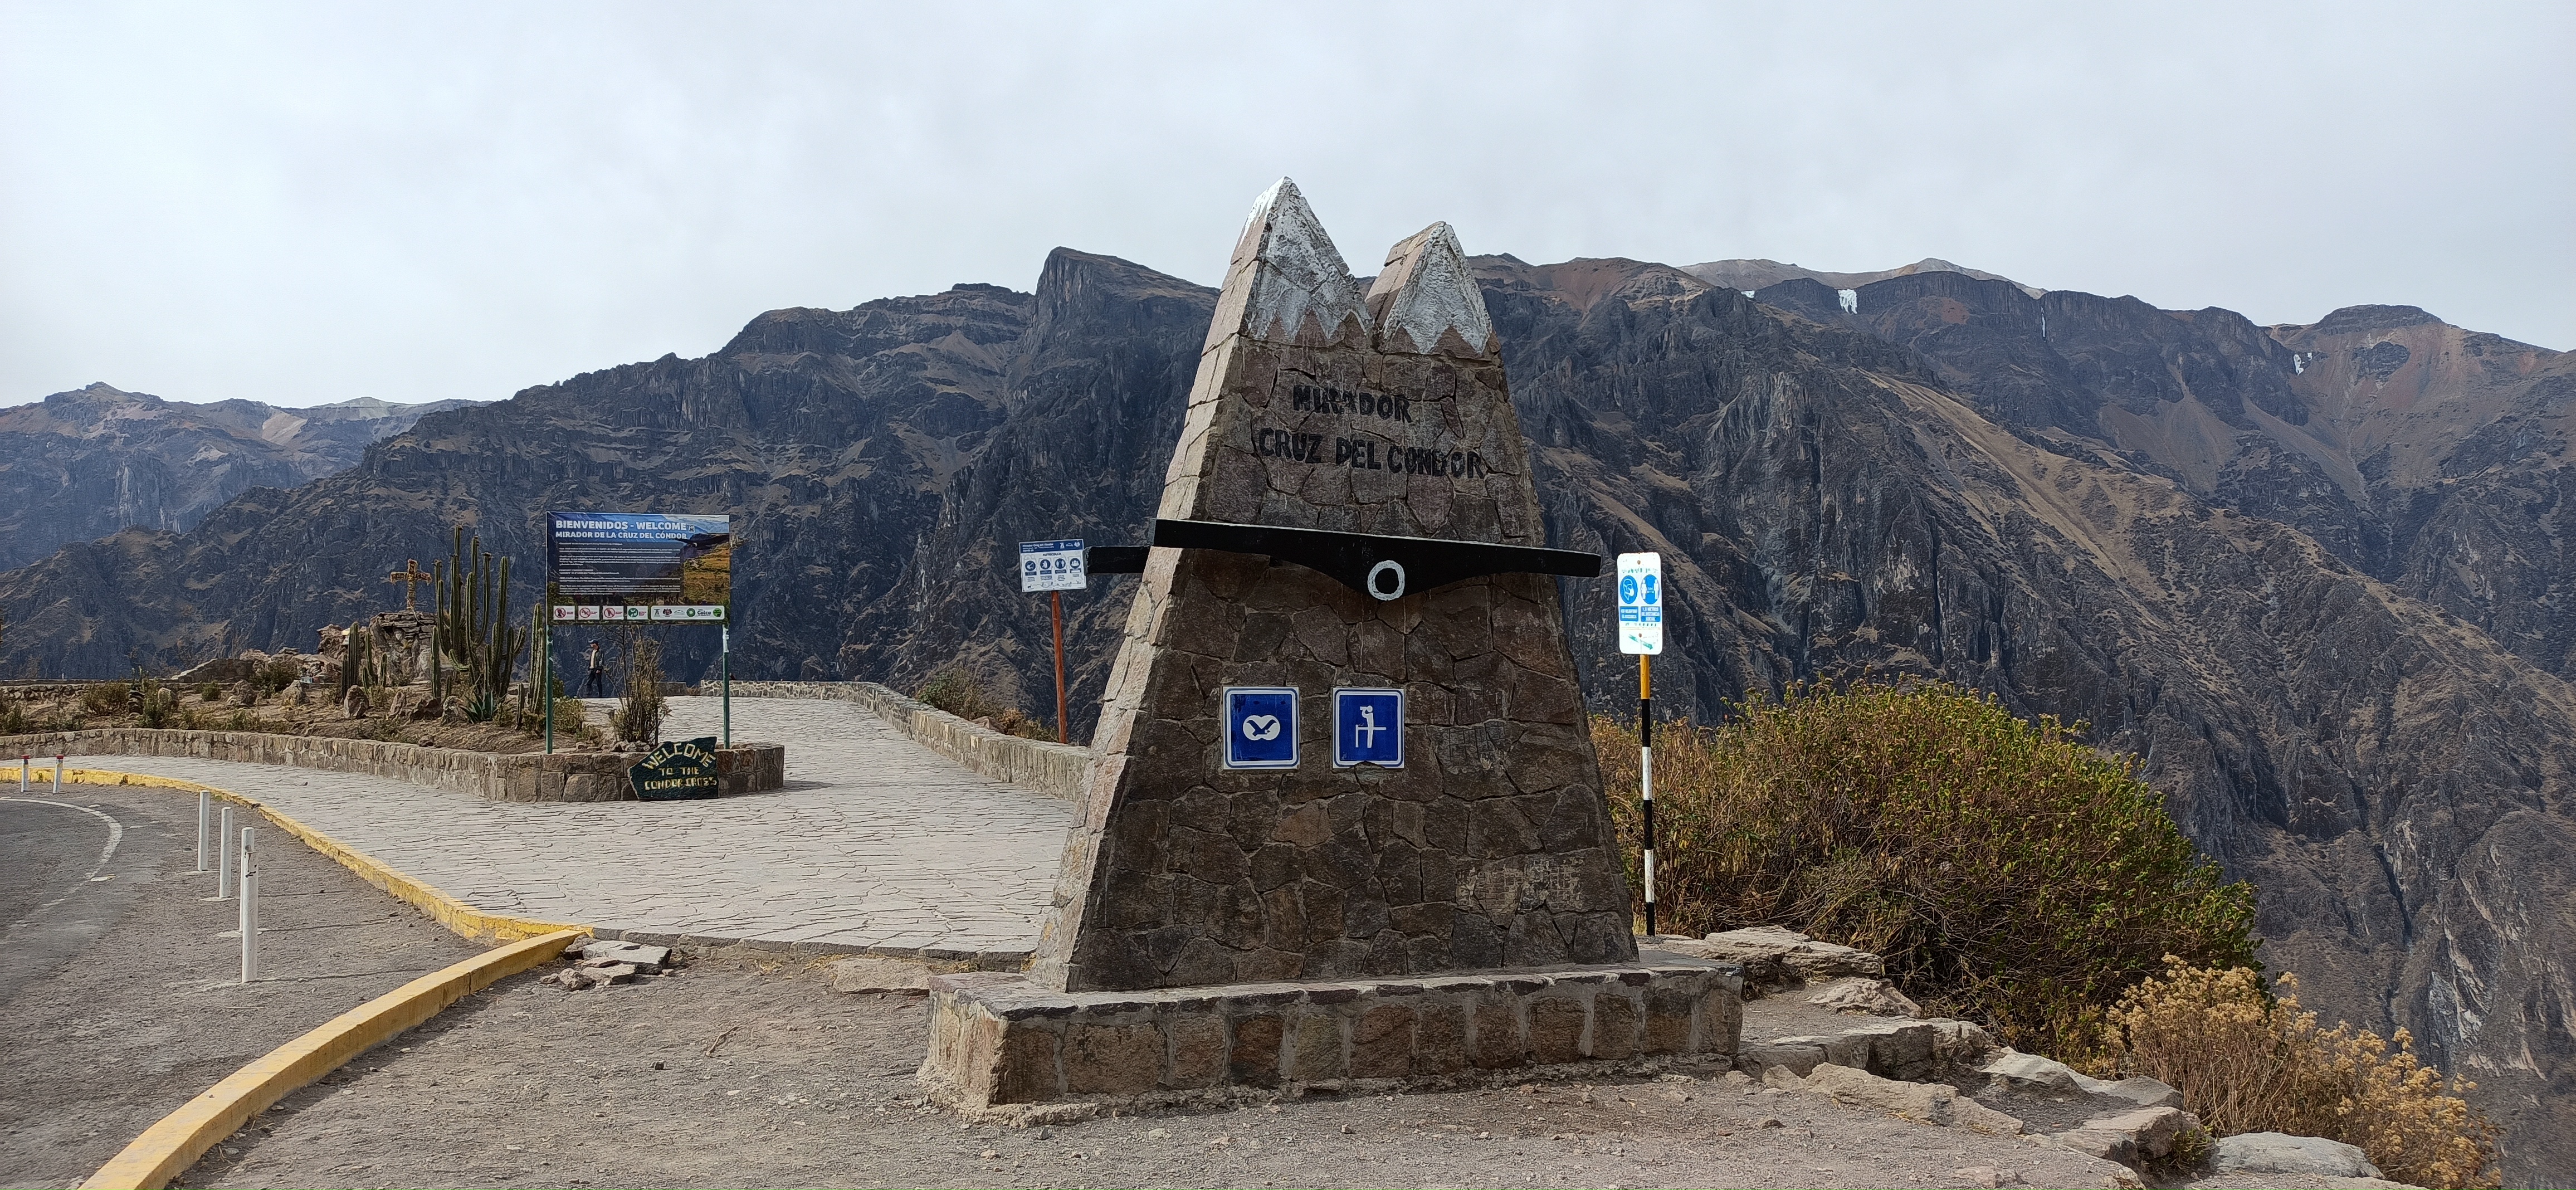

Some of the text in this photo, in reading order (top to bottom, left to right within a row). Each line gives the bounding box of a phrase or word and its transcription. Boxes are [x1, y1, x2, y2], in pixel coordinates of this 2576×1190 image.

[1292, 384, 1413, 423] MIRADOR
[1258, 427, 1485, 479] CRUZ DEL CONDOR
[555, 520, 628, 530] BIENVENIDOS
[636, 522, 687, 530] WELCOME
[642, 743, 716, 769] WELCOME
[659, 767, 700, 776] TO THE
[645, 778, 683, 791] CONDOR
